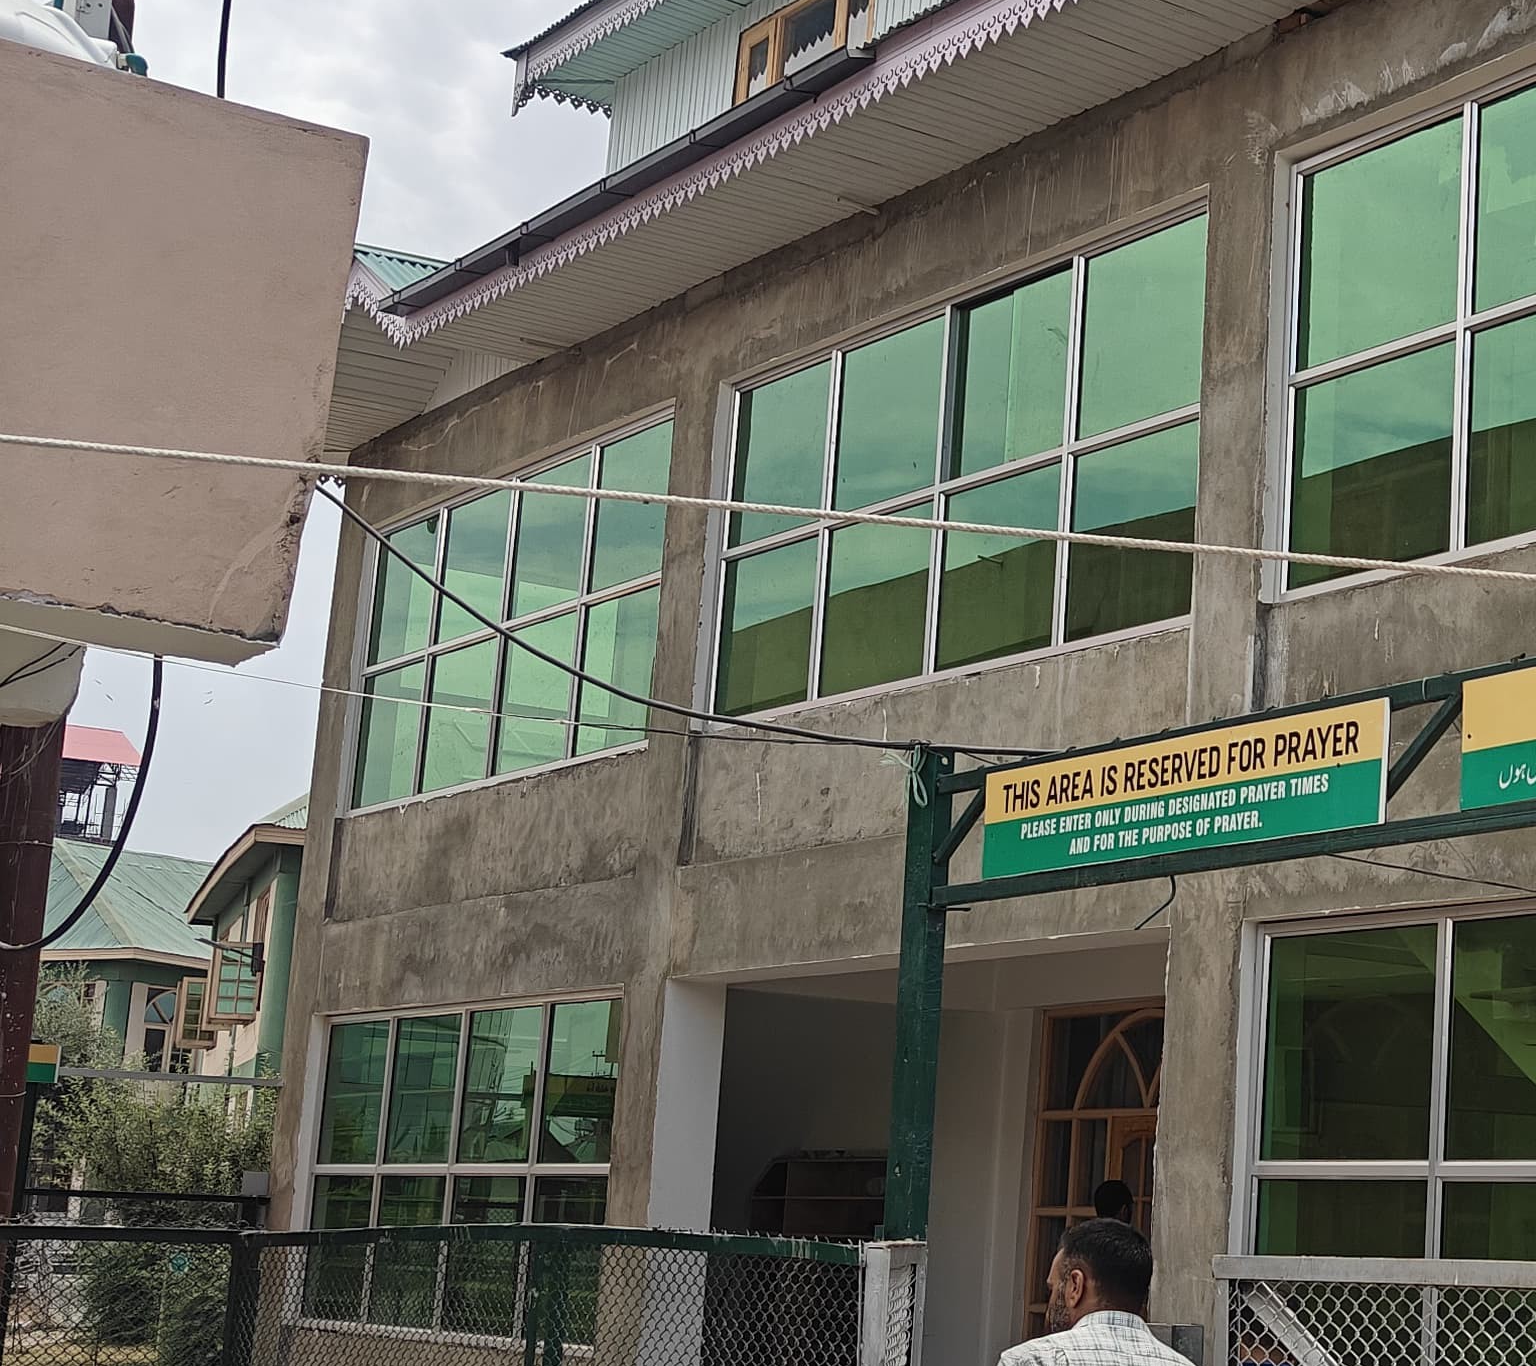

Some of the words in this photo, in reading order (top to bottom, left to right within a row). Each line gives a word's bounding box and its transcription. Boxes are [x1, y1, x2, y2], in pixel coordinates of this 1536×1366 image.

[1002, 779, 1041, 814] THIS
[1045, 769, 1094, 806] AREA
[1100, 764, 1118, 797] IS
[1123, 745, 1221, 793] RESERVED
[1227, 737, 1266, 775] FOR
[1273, 721, 1360, 767] PRAYER
[1499, 763, 1527, 789] ہوں
[1020, 818, 1057, 840] PLEASE
[1059, 813, 1092, 833] ENTER
[1094, 807, 1122, 828] ONLY
[1124, 800, 1165, 824] DURING
[1168, 788, 1236, 817] DESIGNATED
[1239, 778, 1286, 805] PRAYER
[1289, 773, 1329, 797] TIMES
[1068, 837, 1090, 856] AND
[1093, 832, 1115, 852] FOR
[1118, 828, 1139, 848] THE
[1141, 818, 1192, 845] PURPOSE
[1195, 817, 1211, 836] OF
[1214, 810, 1263, 833] PRAYER.
